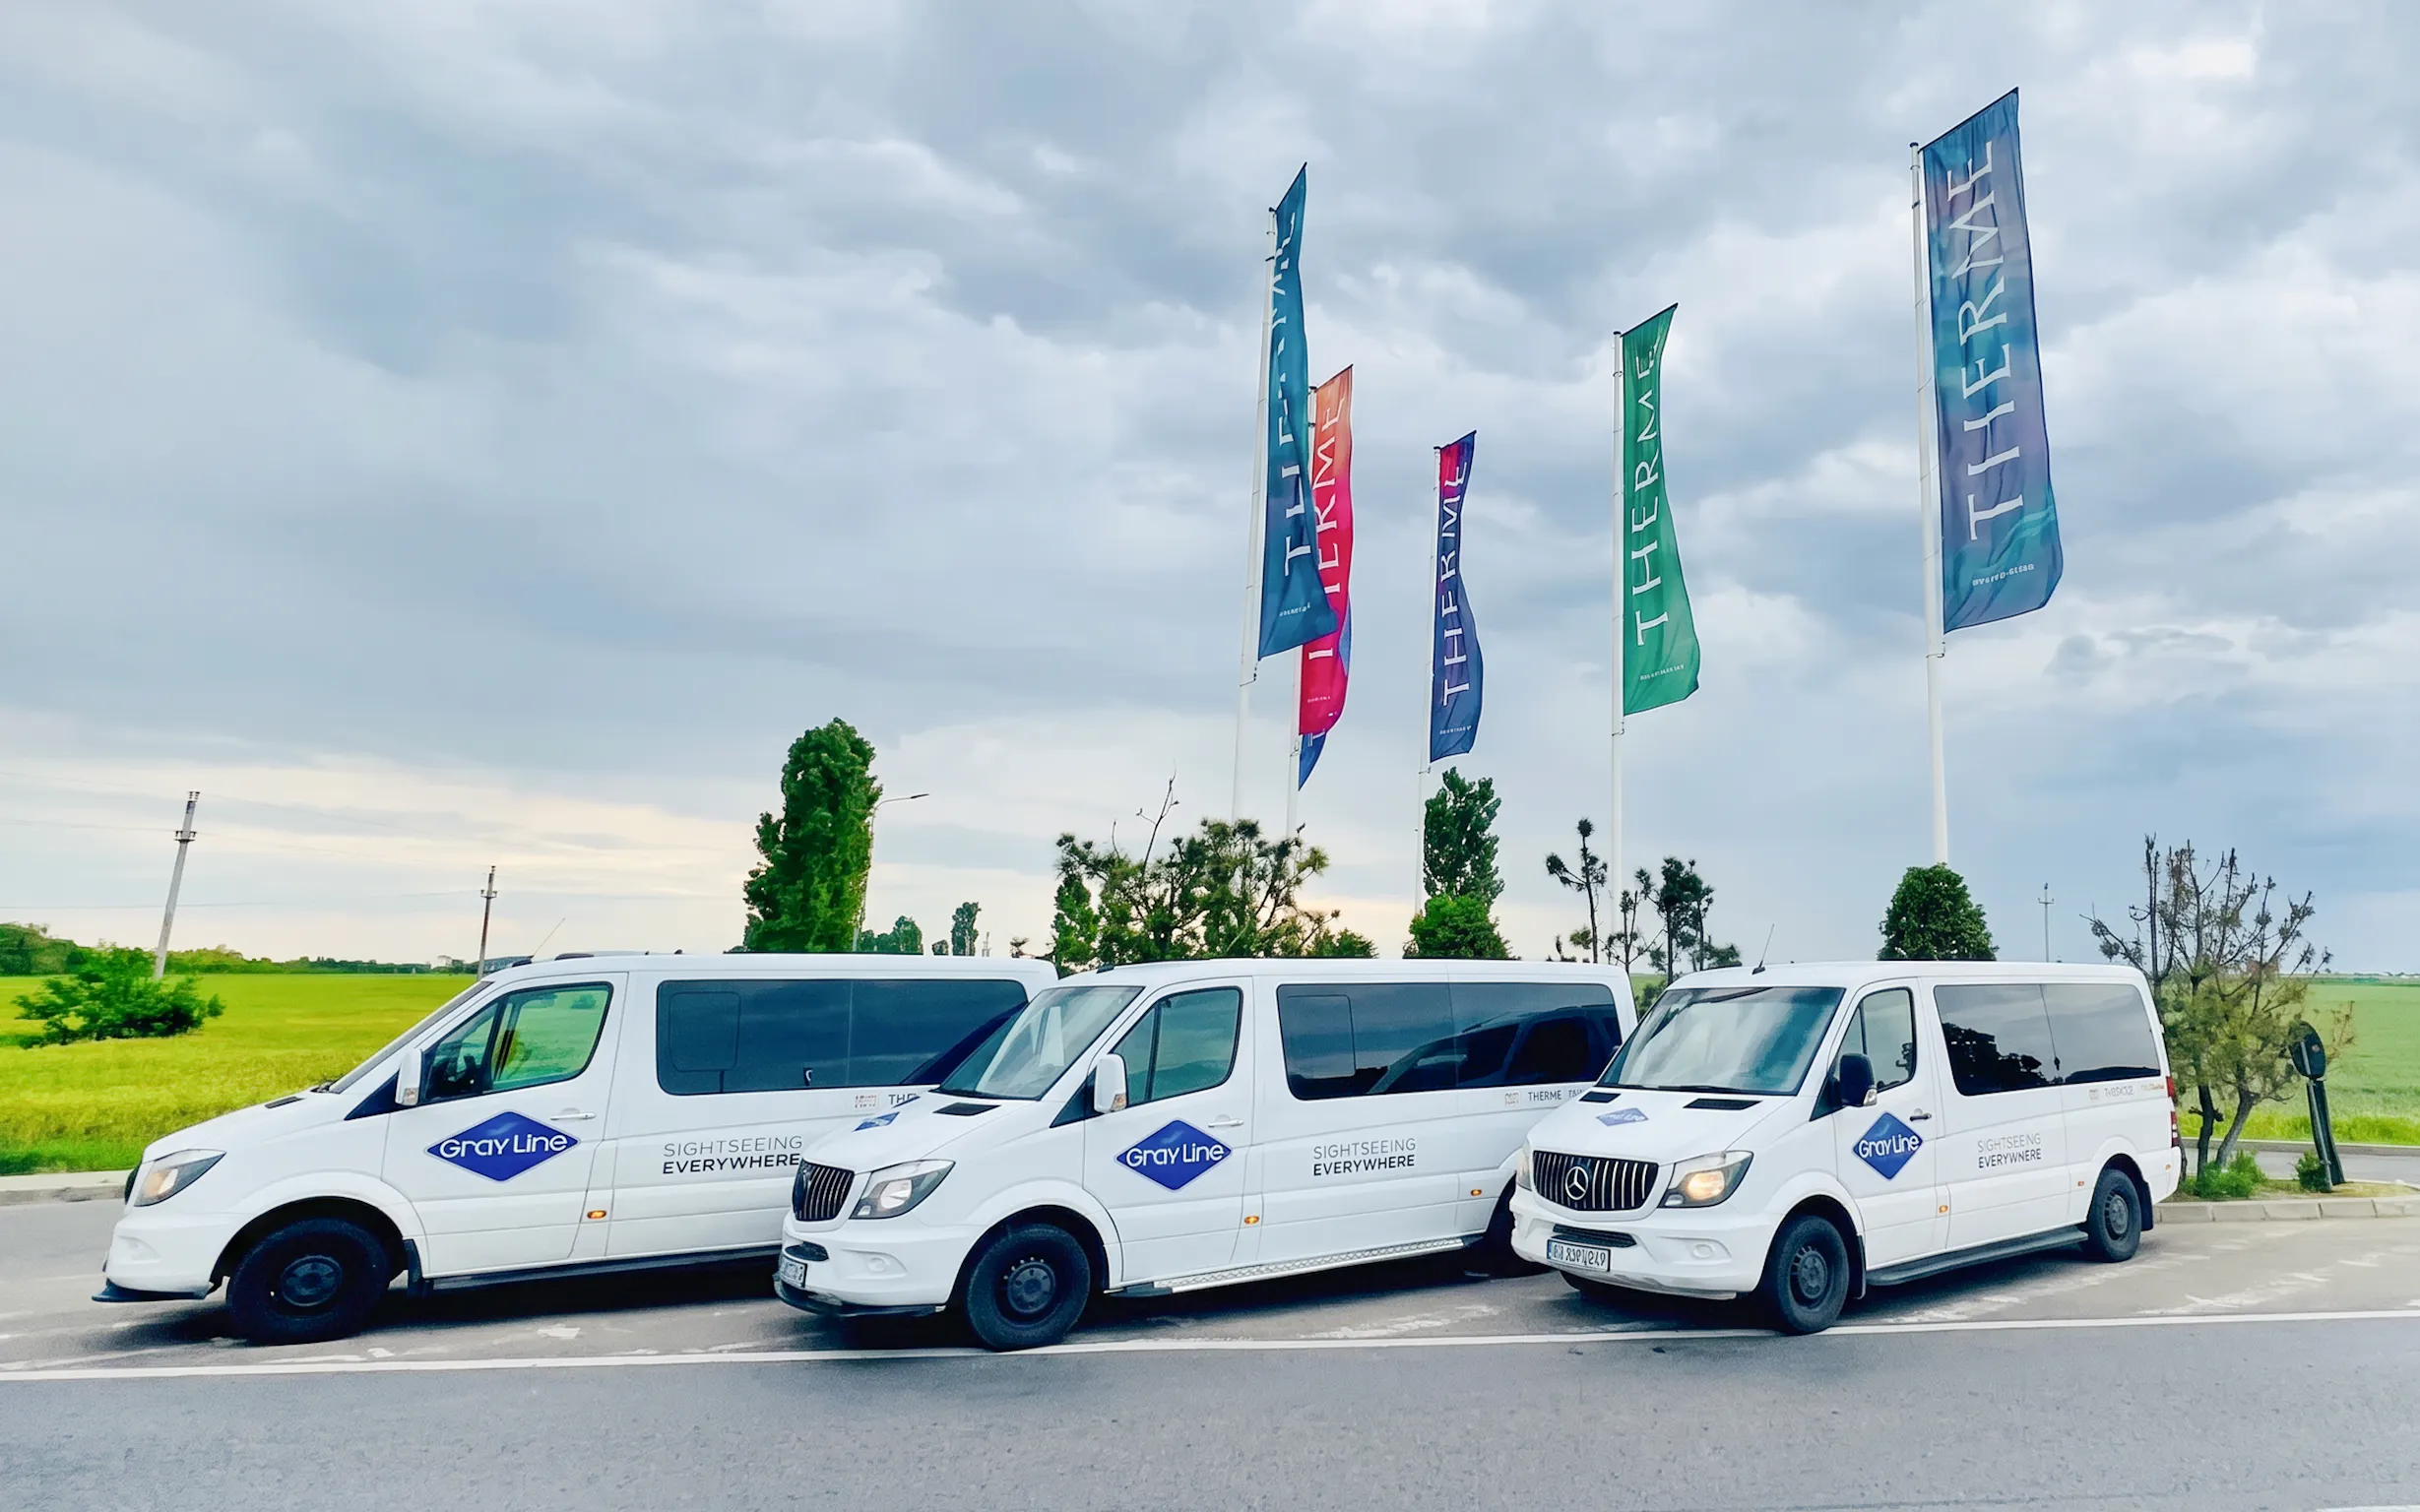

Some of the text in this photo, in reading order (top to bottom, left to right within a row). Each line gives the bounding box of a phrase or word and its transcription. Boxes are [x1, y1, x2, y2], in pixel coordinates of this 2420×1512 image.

[1947, 141, 2024, 542] THERME
[1631, 335, 1669, 646] THERME
[1440, 462, 1470, 706] THERME
[1528, 1090, 1562, 1102] THERME
[439, 1134, 568, 1159] Gray Line
[664, 1135, 802, 1158] SIGHTSEEING
[1125, 1143, 1225, 1167] Gray Line
[1313, 1138, 1416, 1160] SIGHTSEEING
[1859, 1133, 1920, 1159] Gray Line
[663, 1153, 801, 1174] EVERYWHERE
[1313, 1155, 1416, 1176] EVERYWHERE
